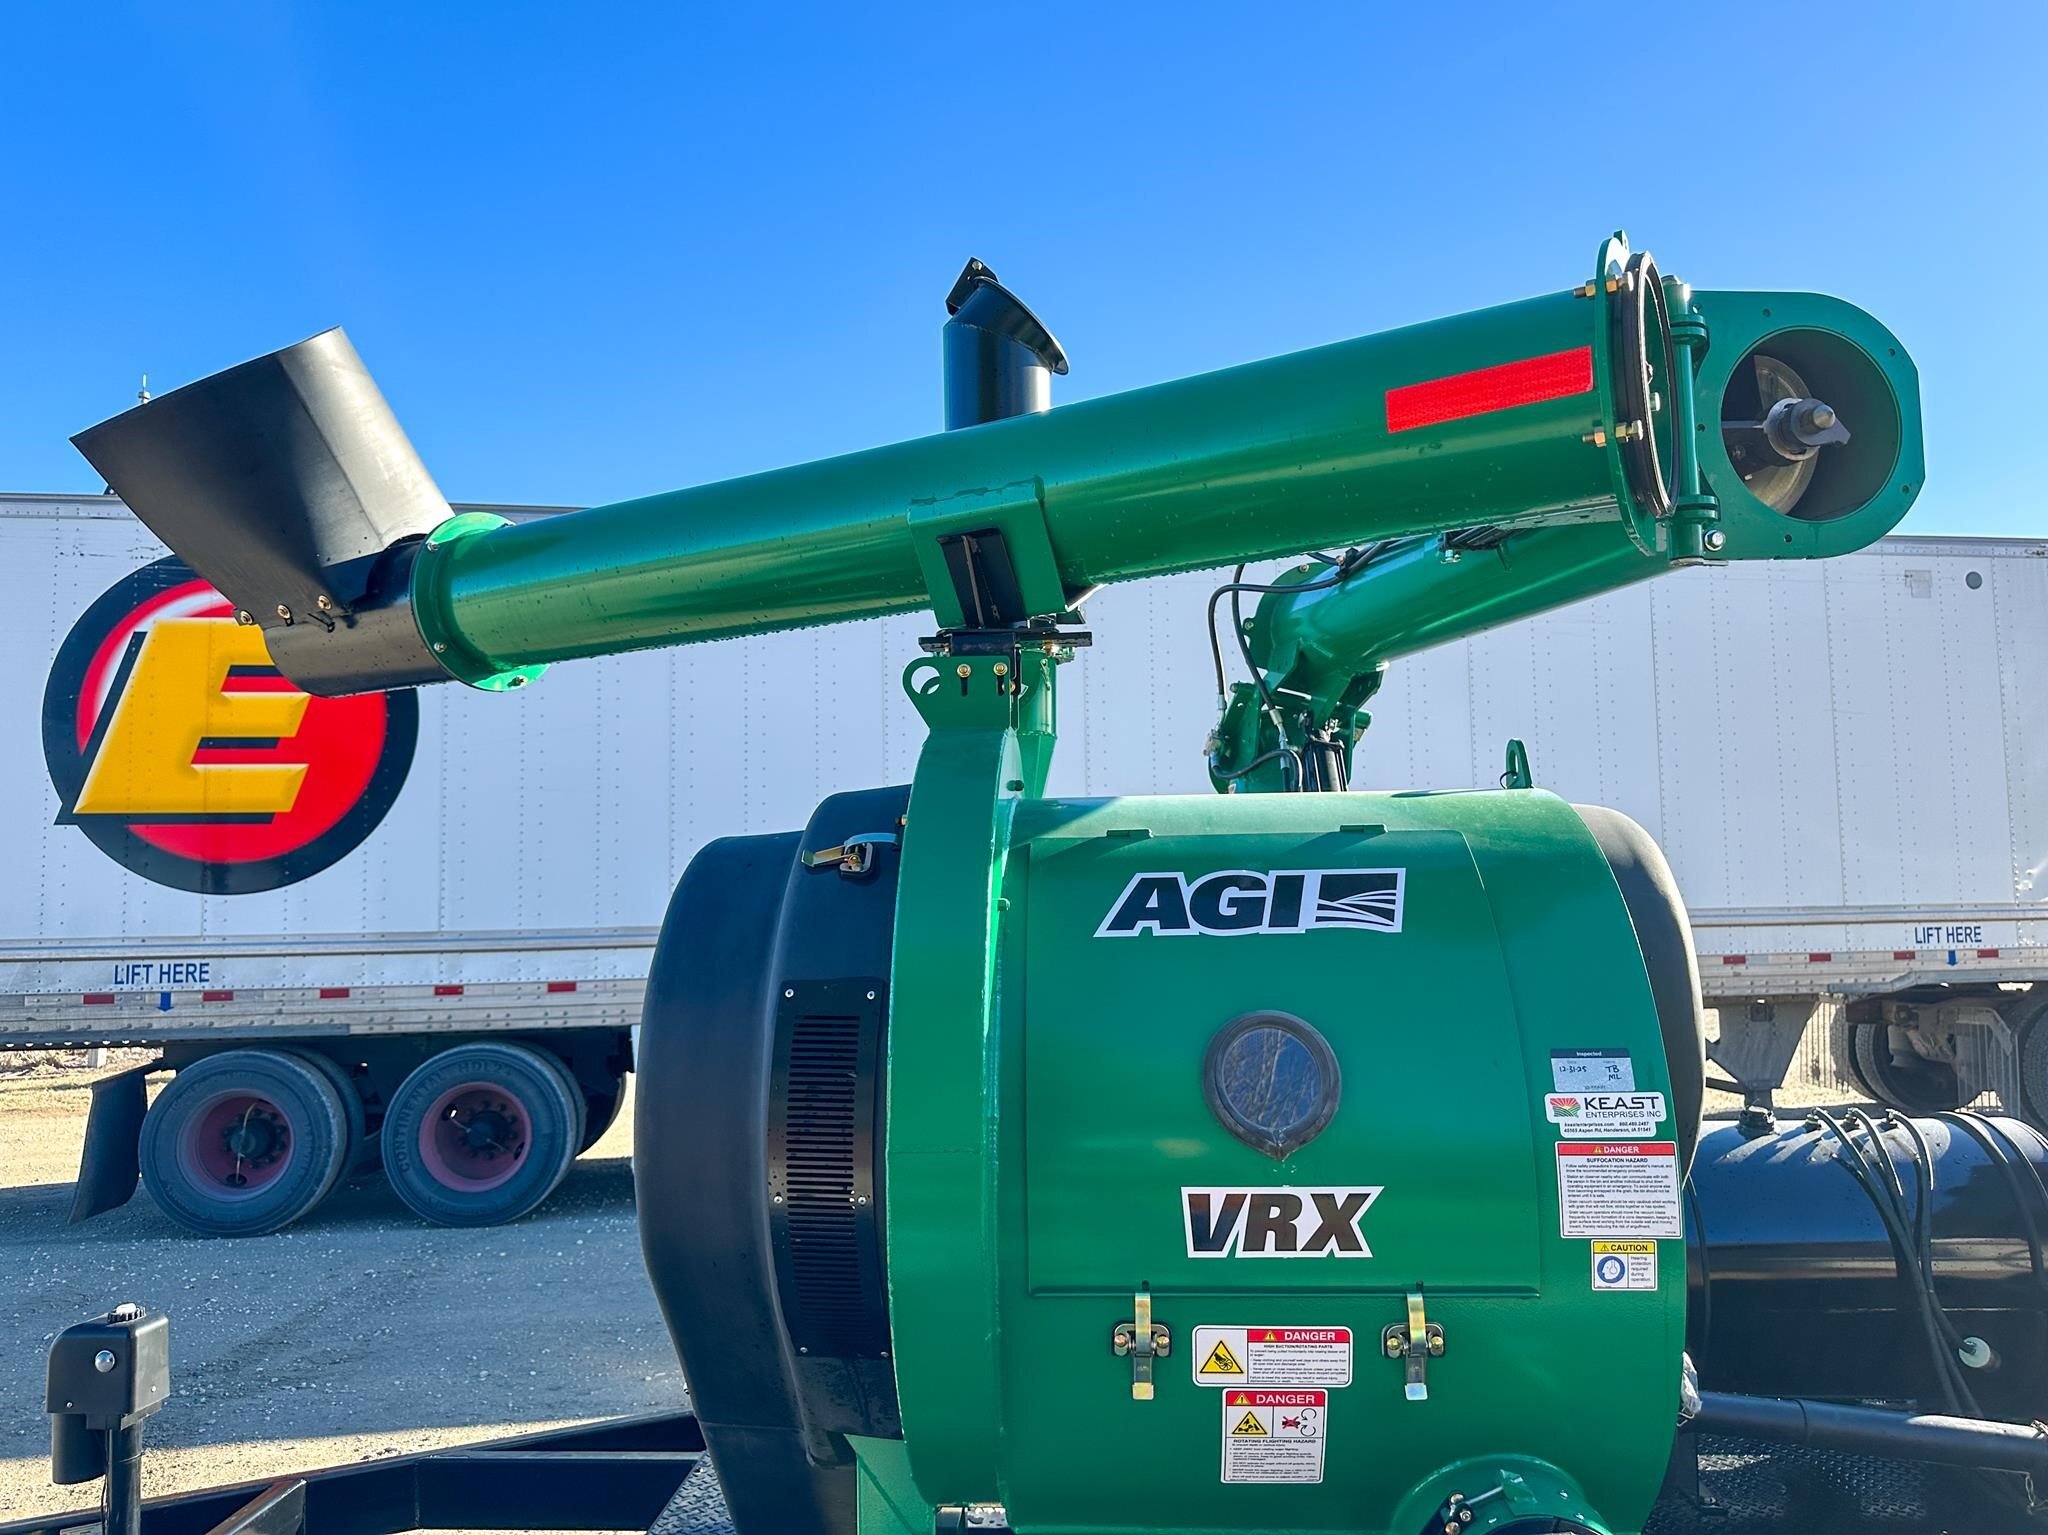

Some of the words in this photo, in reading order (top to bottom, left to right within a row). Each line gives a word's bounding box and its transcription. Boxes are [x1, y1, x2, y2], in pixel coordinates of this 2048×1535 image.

[72, 617, 311, 814] E
[1101, 872, 1306, 934] AGI
[1914, 926, 1942, 944] LIFT
[1946, 926, 1982, 943] HERE
[114, 964, 154, 985] LIFT
[160, 962, 210, 984] HERE
[1605, 1064, 1620, 1073] TB
[1584, 1096, 1659, 1110] KEAST
[1586, 1110, 1644, 1118] ENTERPRISES
[1185, 1191, 1375, 1254] VRX
[1284, 1332, 1335, 1340] DANGER
[1256, 1394, 1315, 1404] DANGER
